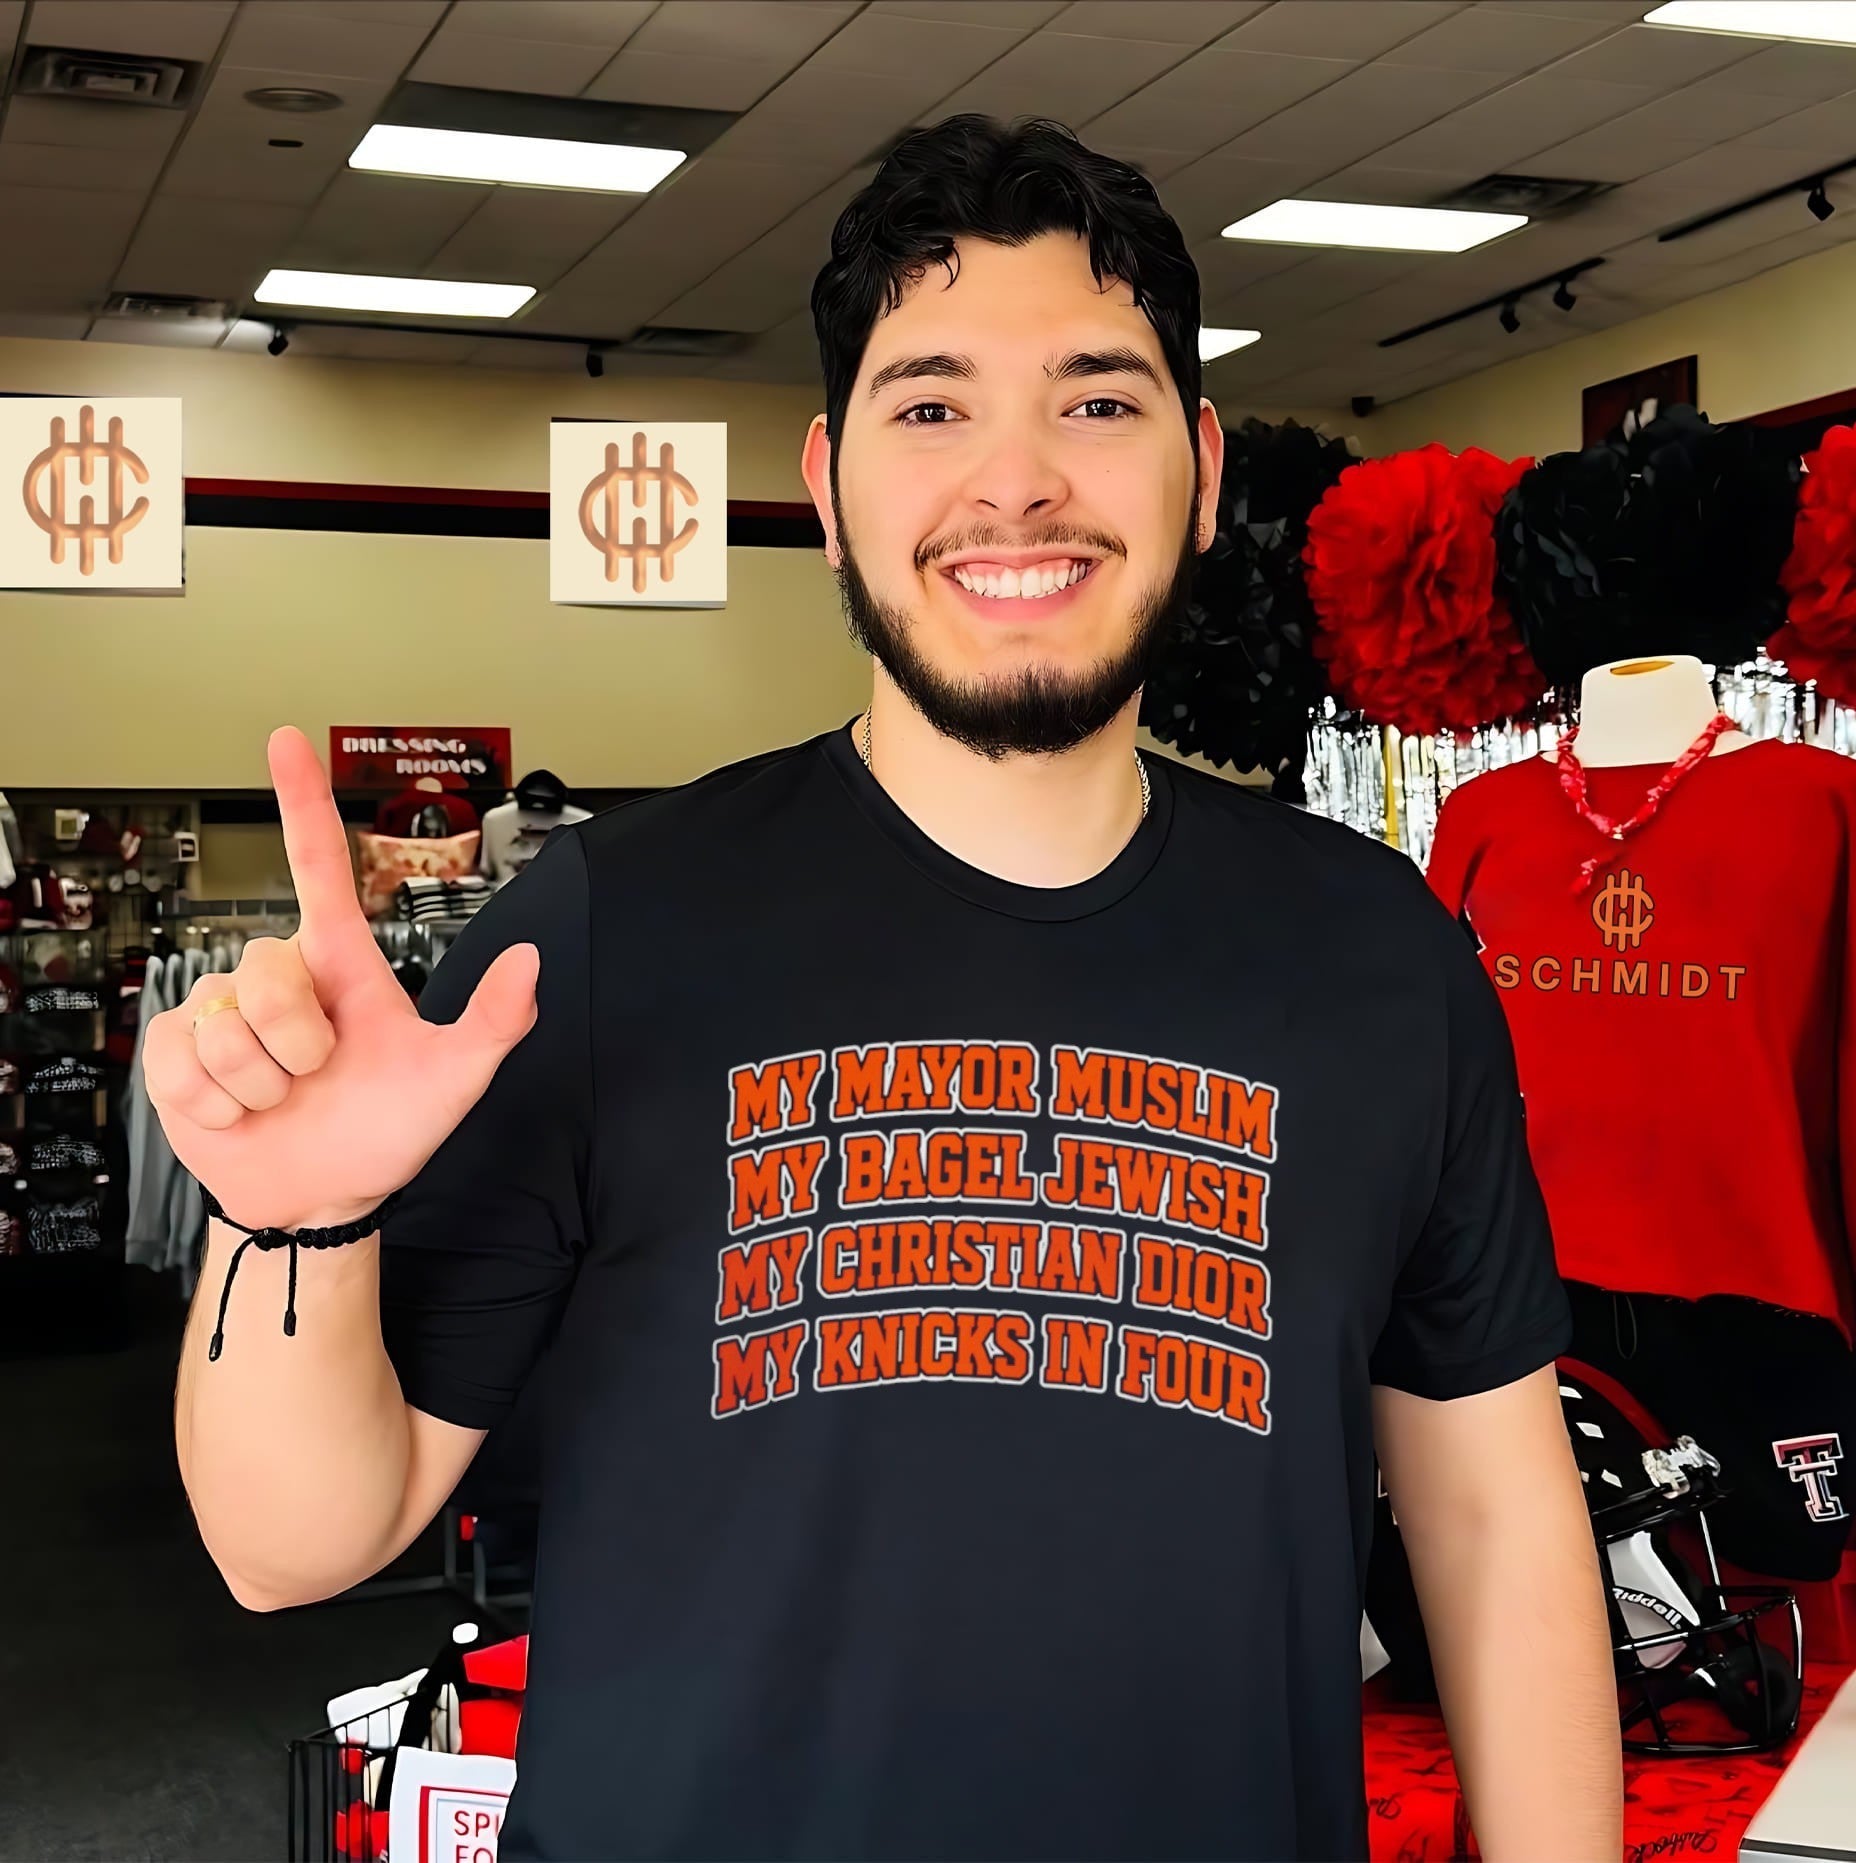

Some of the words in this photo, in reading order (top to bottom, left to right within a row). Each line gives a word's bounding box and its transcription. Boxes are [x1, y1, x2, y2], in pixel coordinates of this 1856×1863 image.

[342, 737, 467, 754] DRESSING
[396, 758, 487, 775] ROOMS
[1494, 954, 1747, 1000] SCHMIDT
[727, 1050, 826, 1145] MY
[830, 1040, 1041, 1123] MAYOR
[1049, 1045, 1279, 1163] MUSLIM
[727, 1136, 830, 1234] MY
[838, 1128, 1038, 1210] BAGEL
[1039, 1133, 1270, 1250] JEWISH
[715, 1227, 813, 1325] MY
[816, 1215, 1127, 1303] CHRISTIAN
[1132, 1232, 1272, 1340] DIOR
[711, 1320, 809, 1419] MY
[813, 1307, 1035, 1391] KNICKS
[1039, 1314, 1113, 1394] IN
[1115, 1324, 1272, 1435] FOUR
